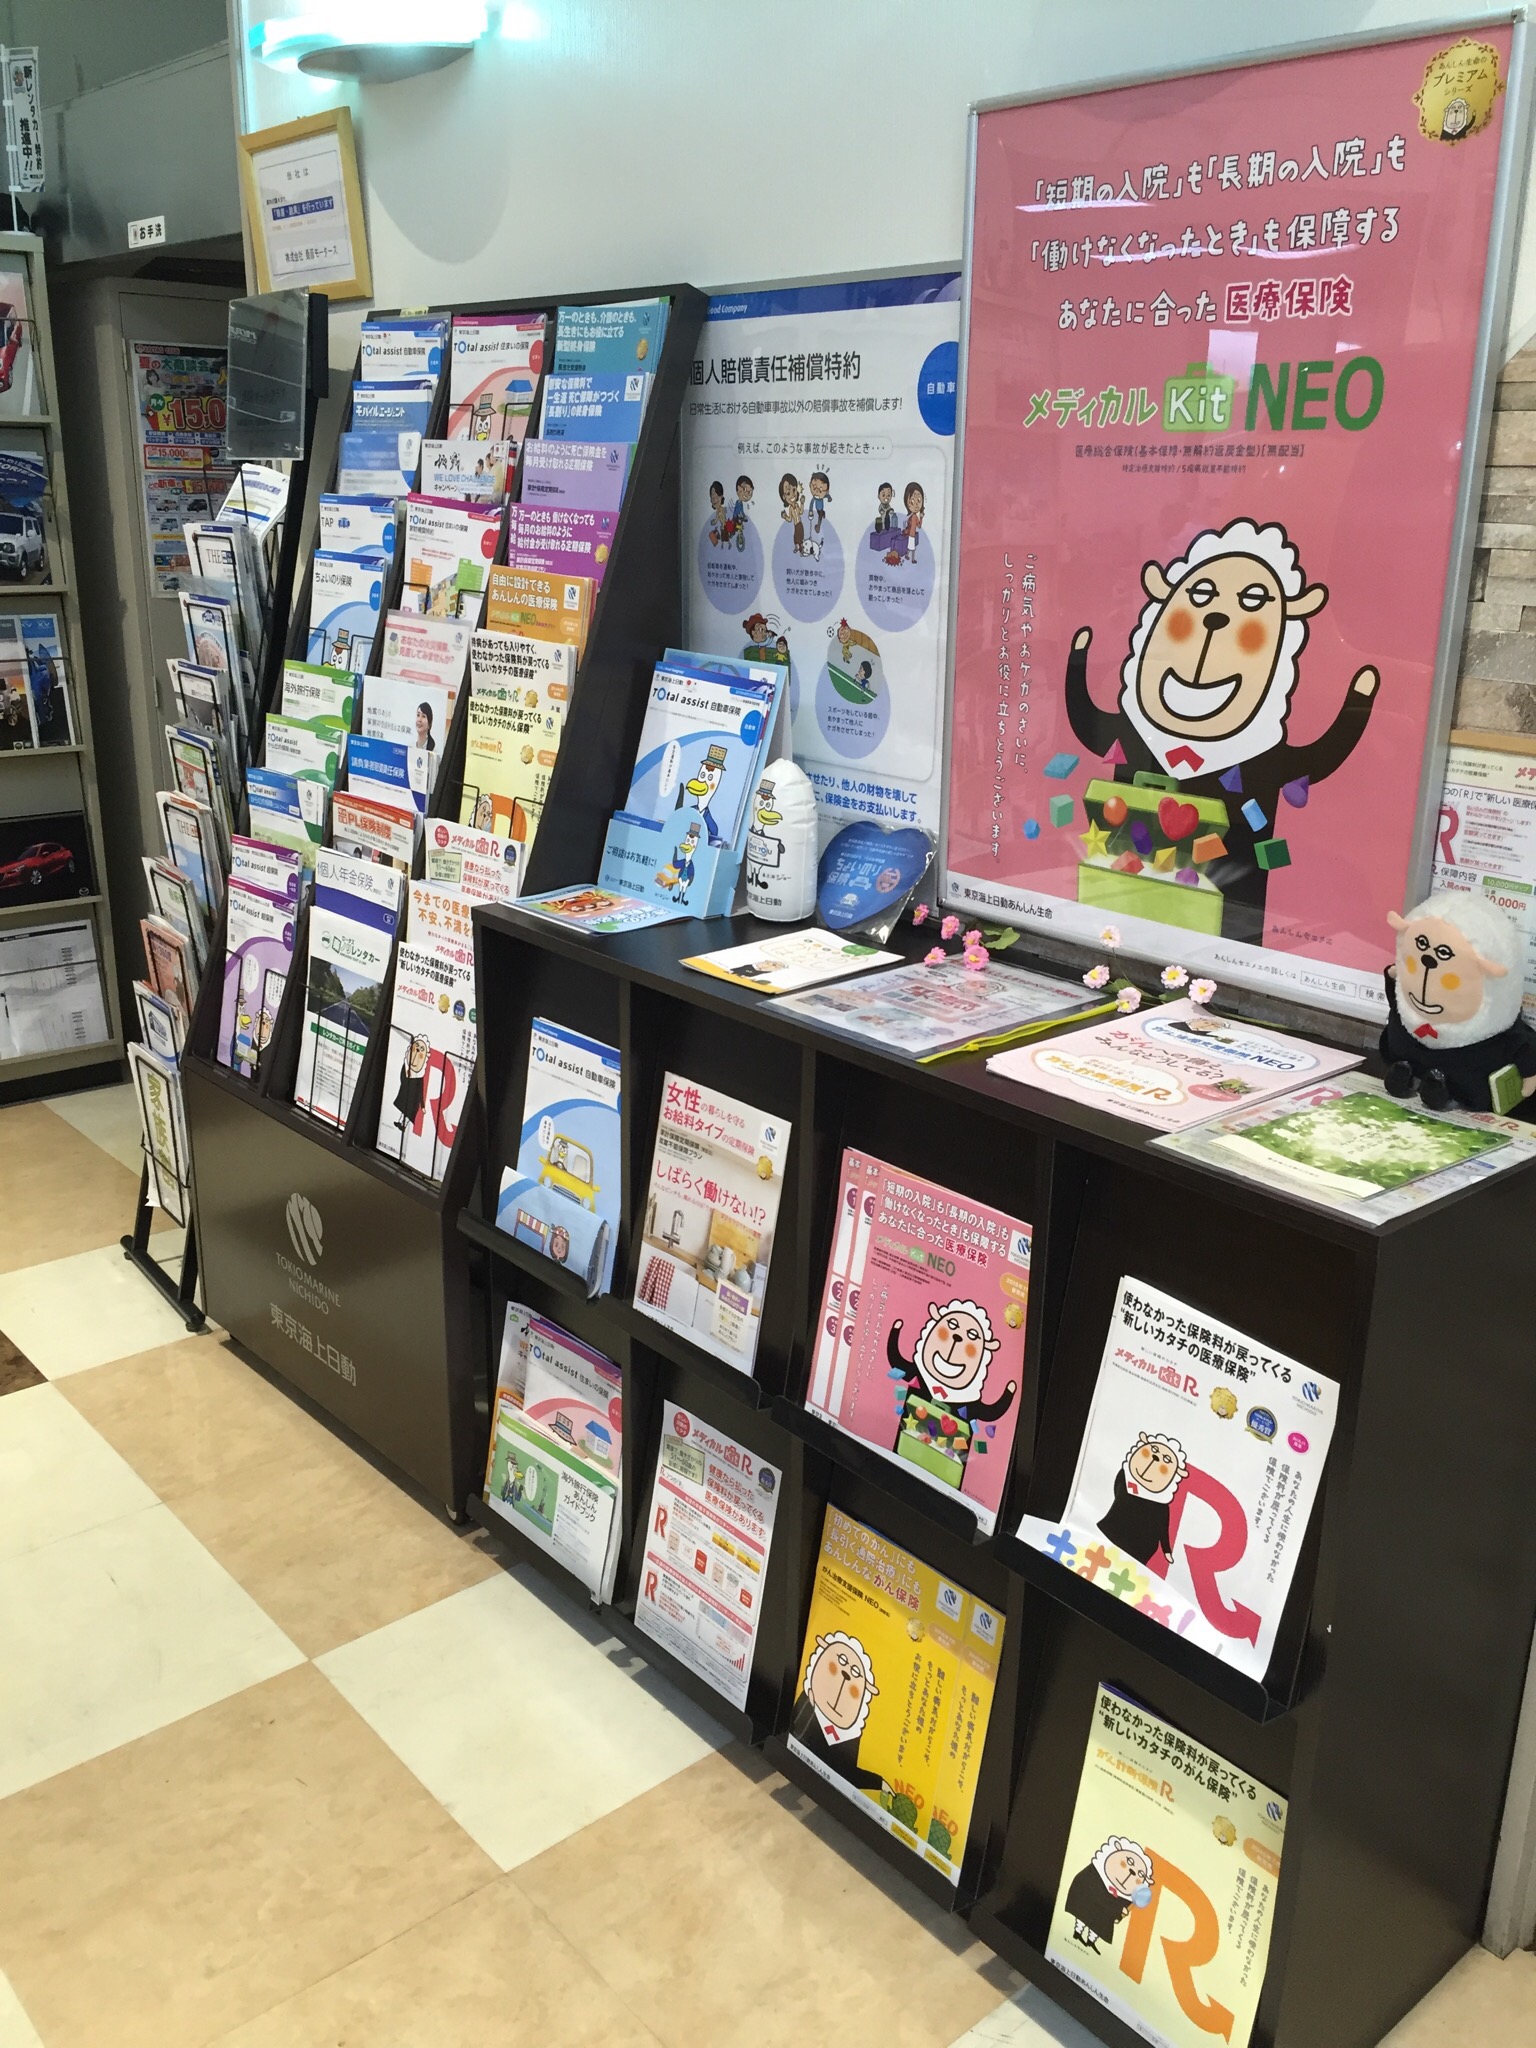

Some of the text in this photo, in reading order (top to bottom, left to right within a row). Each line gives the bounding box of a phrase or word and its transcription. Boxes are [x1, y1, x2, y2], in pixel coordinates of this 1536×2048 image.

[1432, 67, 1490, 87] プレミアム
[1444, 83, 1474, 97] シリーズ
[1033, 135, 1407, 212] 「短期の入院」も「長期の入院」も
[138, 222, 163, 241] お手洗
[1029, 206, 1402, 272] 「働けなくなったとき」も保障する
[722, 302, 749, 315] Company
[1057, 275, 1355, 330] あなたに合った医療保険
[382, 345, 403, 356] assist
[479, 340, 500, 353] assist
[690, 351, 862, 387] 個人賠償責任補償特約
[1167, 383, 1229, 426] Kit
[1244, 355, 1386, 432] NEO
[355, 404, 406, 418] モバイルエージェント
[1022, 387, 1159, 429] メディカル
[433, 473, 443, 483] WE
[444, 473, 461, 484] LOVE
[433, 483, 458, 493] キャンペーン
[320, 516, 334, 529] TAP
[428, 519, 445, 529] assist
[314, 571, 353, 588] ちょいのり保険
[491, 572, 552, 595] 自由に設計できる
[491, 588, 559, 612] あんしんの医療保険
[470, 635, 538, 656] 持病があっても入りやすく、
[470, 648, 551, 671] 使わなかった保険料が戻ってくる
[469, 700, 542, 725] 使わなかった保険料が戻ってくる
[680, 694, 742, 718] assist 自動車保険
[489, 840, 501, 858] R
[606, 844, 658, 869] ご相談はお気軽に!
[250, 862, 267, 873] assist
[318, 860, 375, 893] 個人年金保険
[1440, 867, 1478, 883] 保障内容
[245, 907, 261, 919] assist
[963, 886, 1054, 921] 東京海上日動あんしん生命
[399, 946, 472, 982] 使わなかった保険料が戻ってくる
[1303, 974, 1348, 993] あんしん生命
[1094, 1034, 1225, 1080] みんなどうしてる?
[1108, 1028, 1223, 1073] がんへの備え、
[1247, 1053, 1297, 1072] NEO
[557, 1058, 617, 1091] assist 自動車保険
[666, 1081, 746, 1130] 女性の暮らしを守る
[1142, 1084, 1174, 1103] R
[663, 1105, 756, 1158] お給料タイプの定期保険
[655, 1159, 767, 1228] しばらく働けない!?
[881, 1178, 1010, 1241] 「短期の入院」も「長期の入院」も
[877, 1211, 989, 1269] あなたに合った医療保険
[878, 1195, 1007, 1258] 「働けなくなったとき」も保障する
[927, 1251, 957, 1278] NEO
[275, 1251, 342, 1309] TOKIO MARINE
[288, 1277, 330, 1316] NICHIDO
[269, 1301, 358, 1388] 東京海上日動
[1118, 1306, 1258, 1385] “新しいカタチの医療保険”
[1121, 1290, 1294, 1385] 使わなかった保険料が戻ってくる
[1113, 1347, 1159, 1377] メディカル
[553, 1358, 611, 1399] assist 住まいの保険
[1159, 1367, 1182, 1389] Kit
[1182, 1373, 1200, 1399] R
[691, 1427, 724, 1455] メディカル
[741, 1453, 754, 1477] R
[560, 1469, 600, 1507] 海外旅行保険
[572, 1488, 598, 1513] あんしん
[562, 1494, 597, 1524] ガイドブック
[1263, 1463, 1291, 1544] 保険料が戻ってくる
[826, 1509, 918, 1576] 「初めてのがん」にも
[823, 1540, 922, 1613] あんしんながん保険
[863, 1592, 881, 1611] NEO
[1097, 1709, 1239, 1804] “新しいカタチのがん保険”
[1099, 1694, 1258, 1801] 使わなかった保険料が戻ってくる
[1159, 1779, 1176, 1804] R
